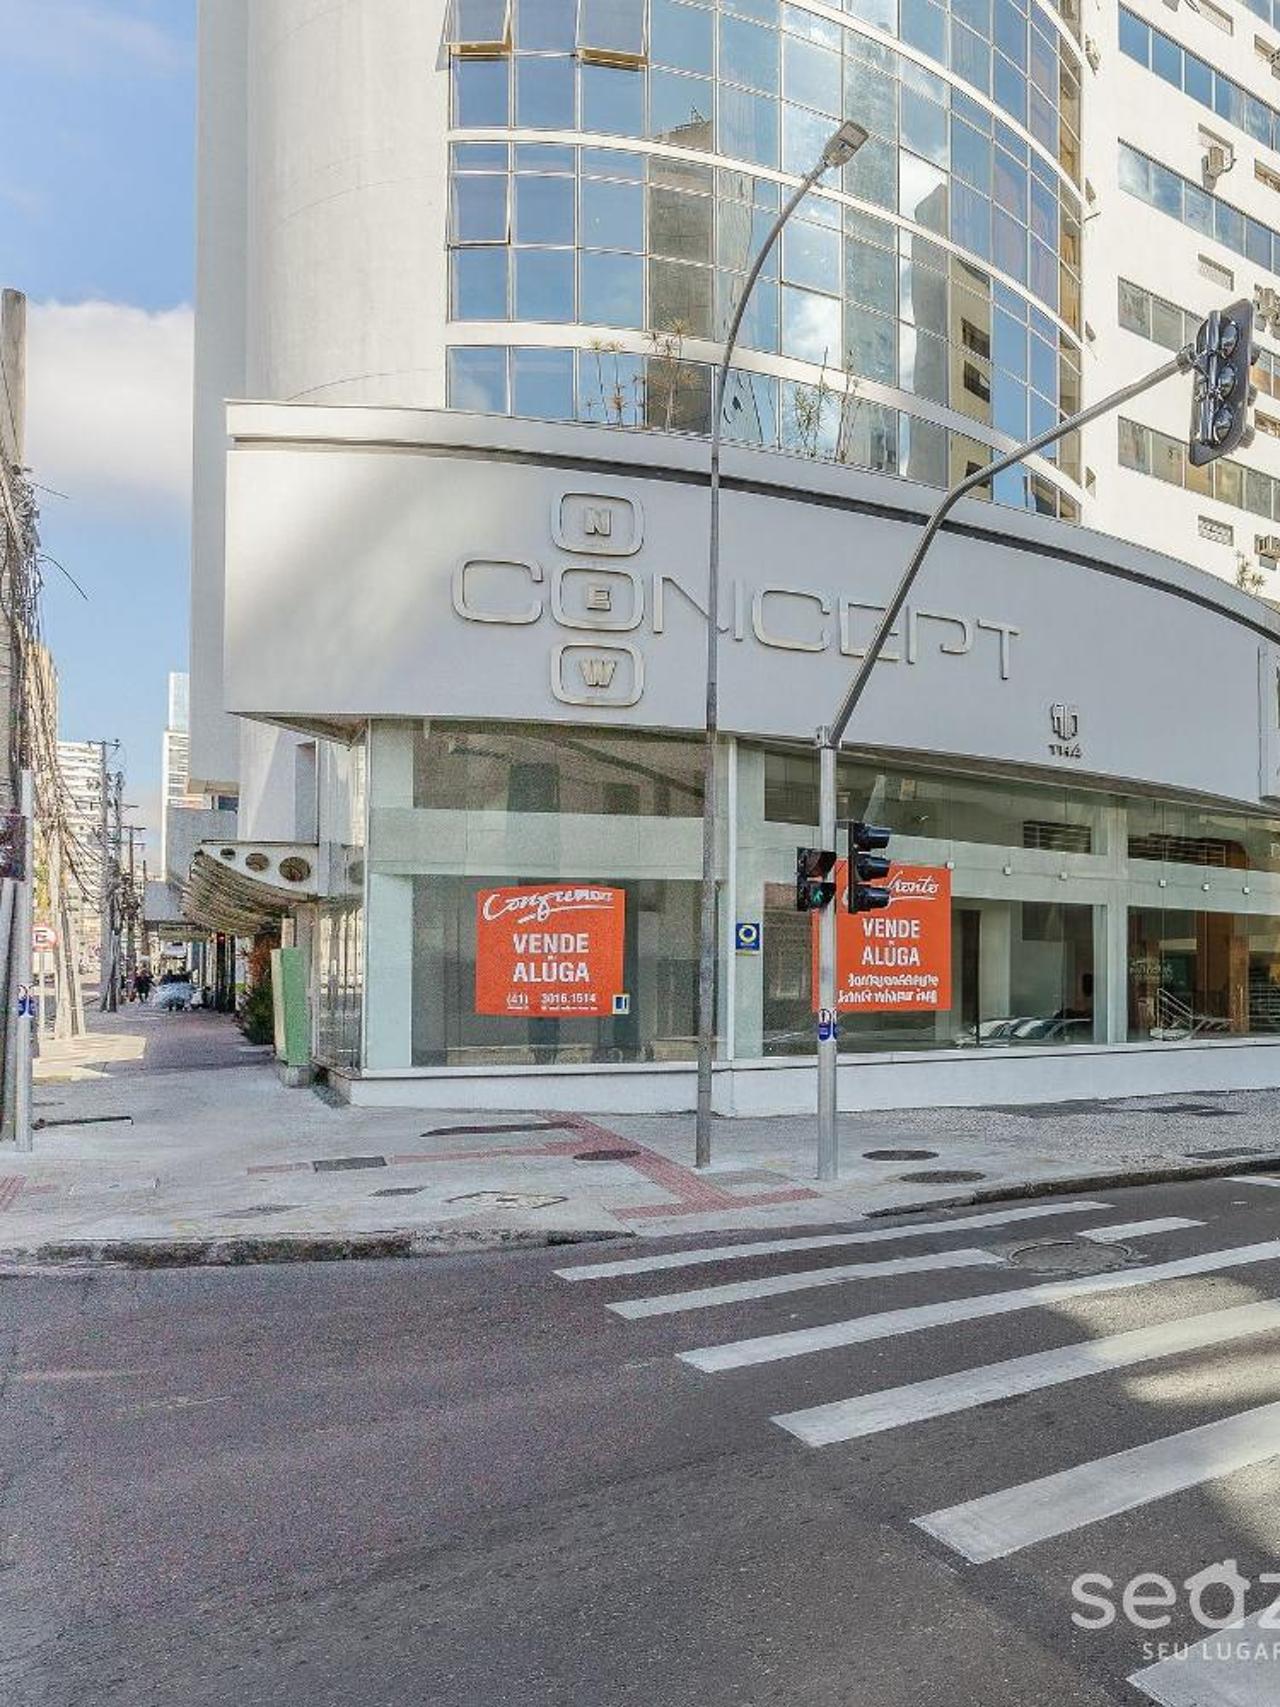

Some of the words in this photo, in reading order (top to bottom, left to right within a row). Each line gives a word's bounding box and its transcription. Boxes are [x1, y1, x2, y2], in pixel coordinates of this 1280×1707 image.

[451, 557, 1021, 681] CONCEPT
[862, 917, 921, 938] VENDE
[512, 933, 590, 954] VENDE
[861, 945, 921, 967] ALUGA
[512, 962, 591, 983] ALUGA
